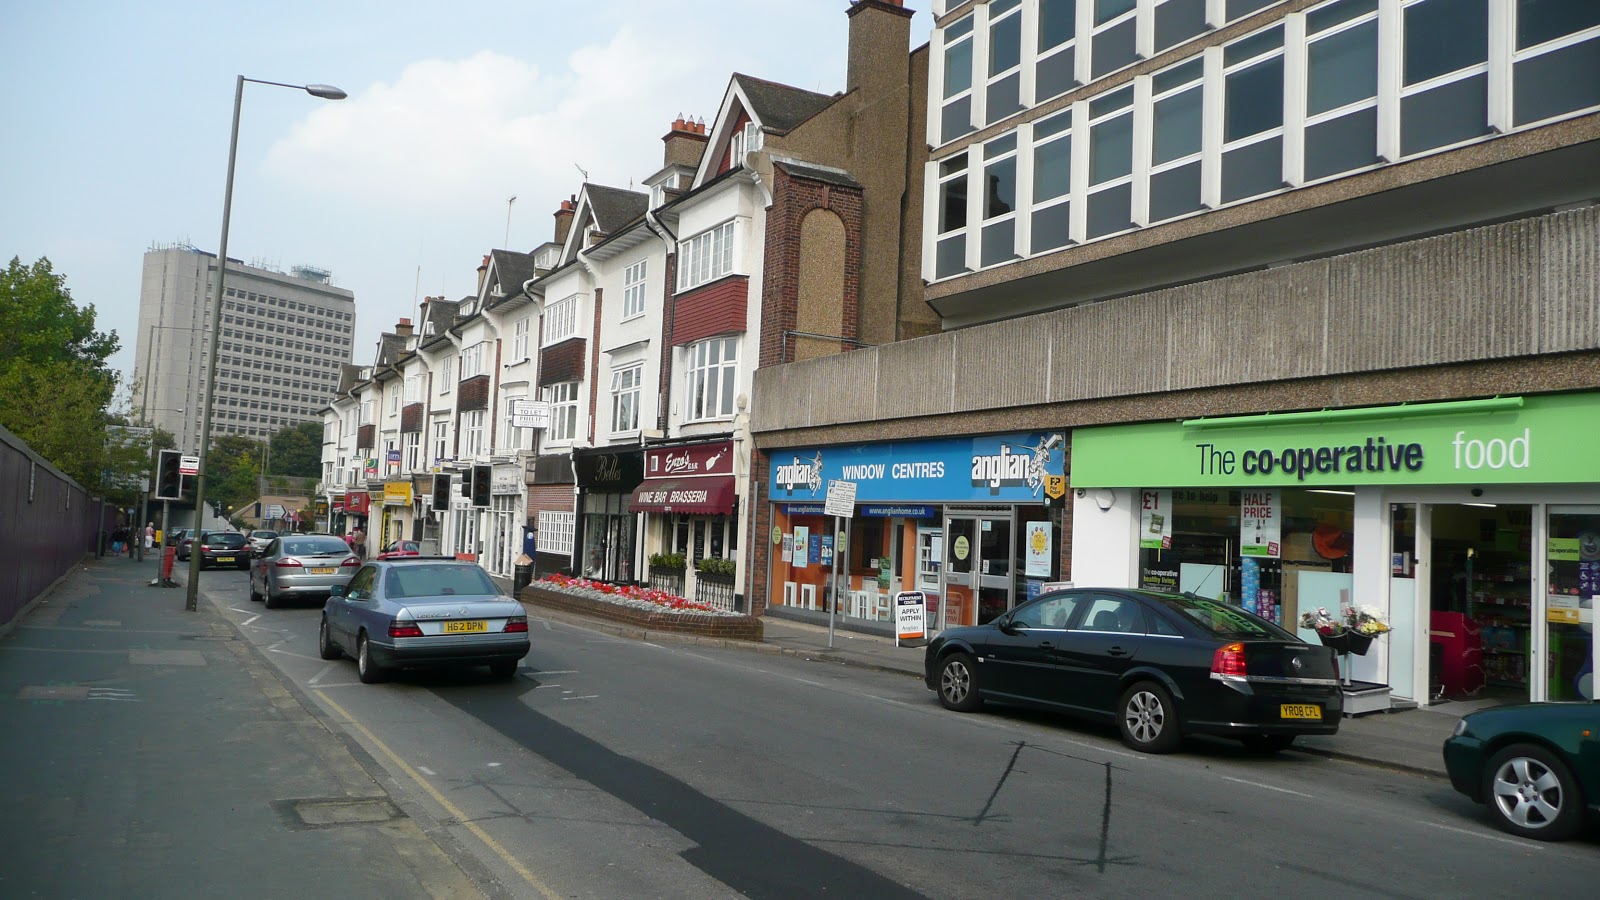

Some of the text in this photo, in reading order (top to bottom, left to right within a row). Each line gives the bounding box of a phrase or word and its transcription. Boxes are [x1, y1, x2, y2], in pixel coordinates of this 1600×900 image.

[1196, 428, 1531, 481] The co-operative food
[665, 451, 698, 473] Enzo's BAR
[971, 444, 1030, 488] anglian
[776, 456, 811, 490] anglian
[842, 461, 945, 480] WINDOW CENTRES
[638, 490, 707, 503] WINE BAR BRASSERIA
[1142, 491, 1159, 510] £1
[1199, 490, 1218, 503] help
[1243, 493, 1272, 506] HALF
[868, 506, 926, 516] www.anglianhome.co.uk
[1243, 506, 1272, 519] PRICE
[1151, 569, 1178, 577] co-operative
[447, 621, 484, 631] H62 DPN
[1283, 706, 1319, 717] YR08 CFL
